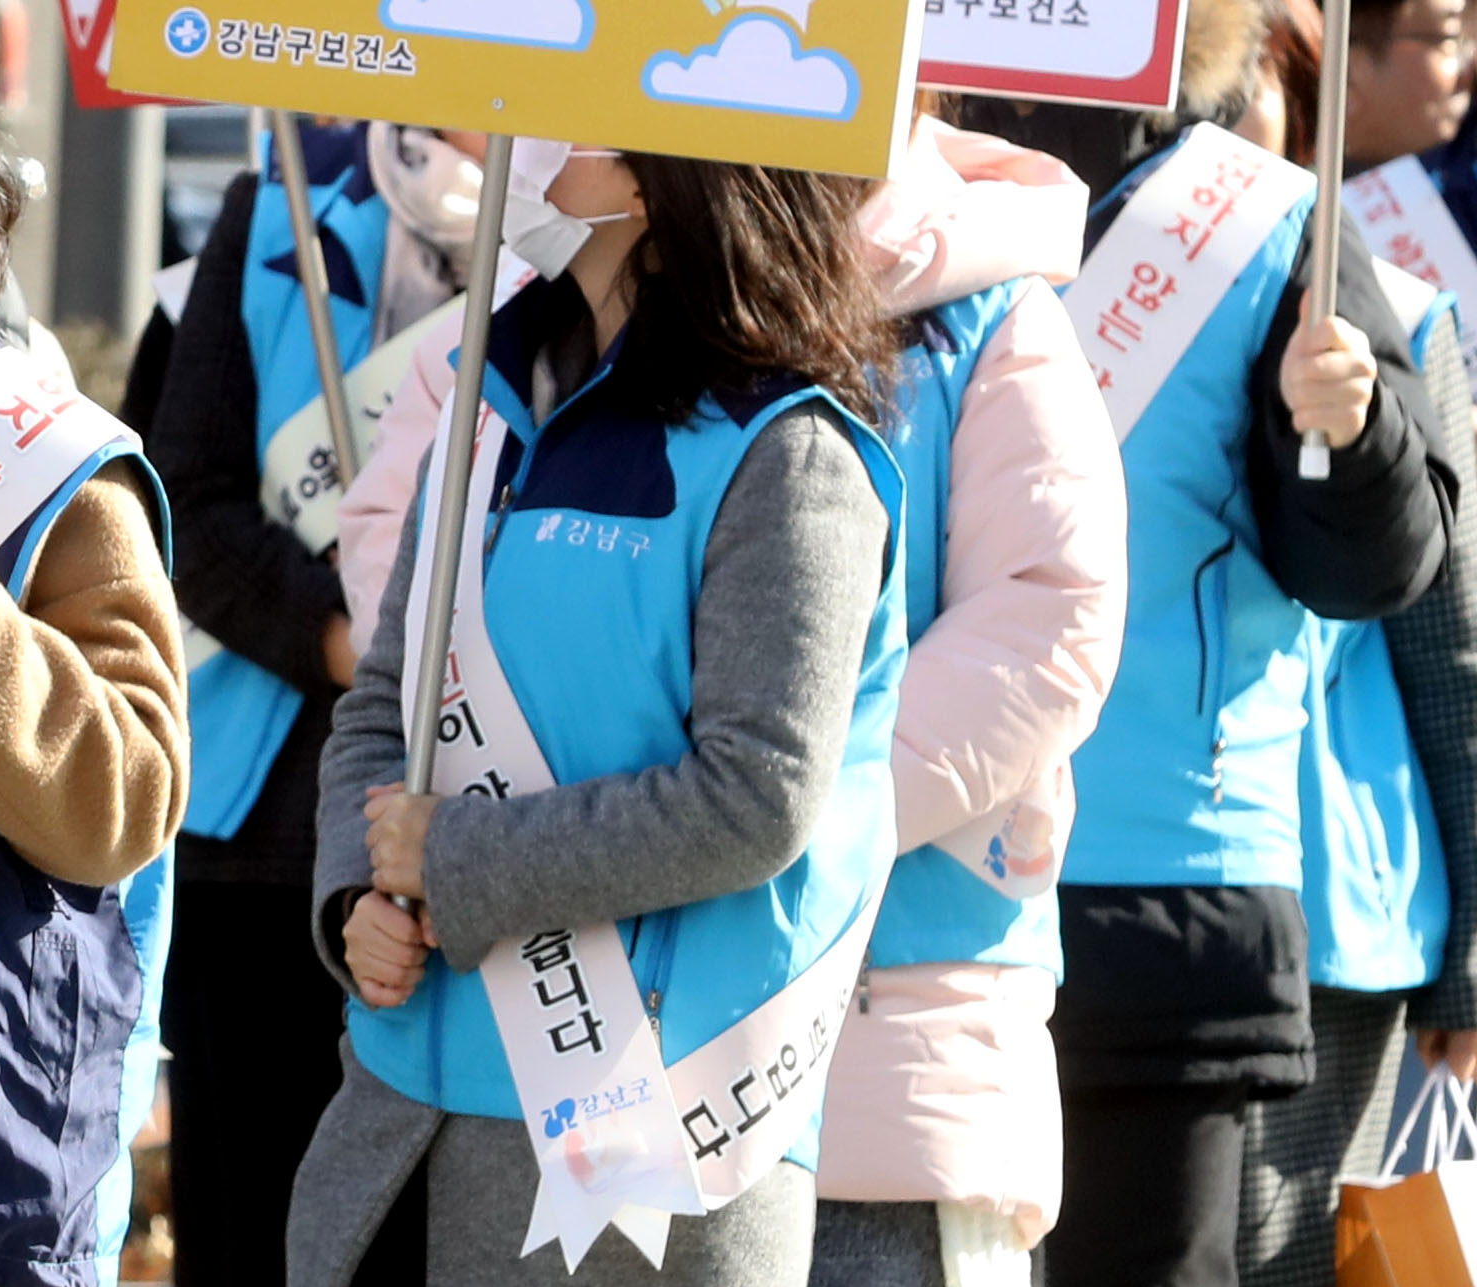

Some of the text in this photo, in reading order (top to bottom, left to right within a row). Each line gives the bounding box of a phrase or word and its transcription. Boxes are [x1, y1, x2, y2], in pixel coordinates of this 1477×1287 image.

[216, 18, 419, 75] 강남구보건소
[1097, 262, 1178, 354] 않는
[565, 518, 654, 561] 강남구
